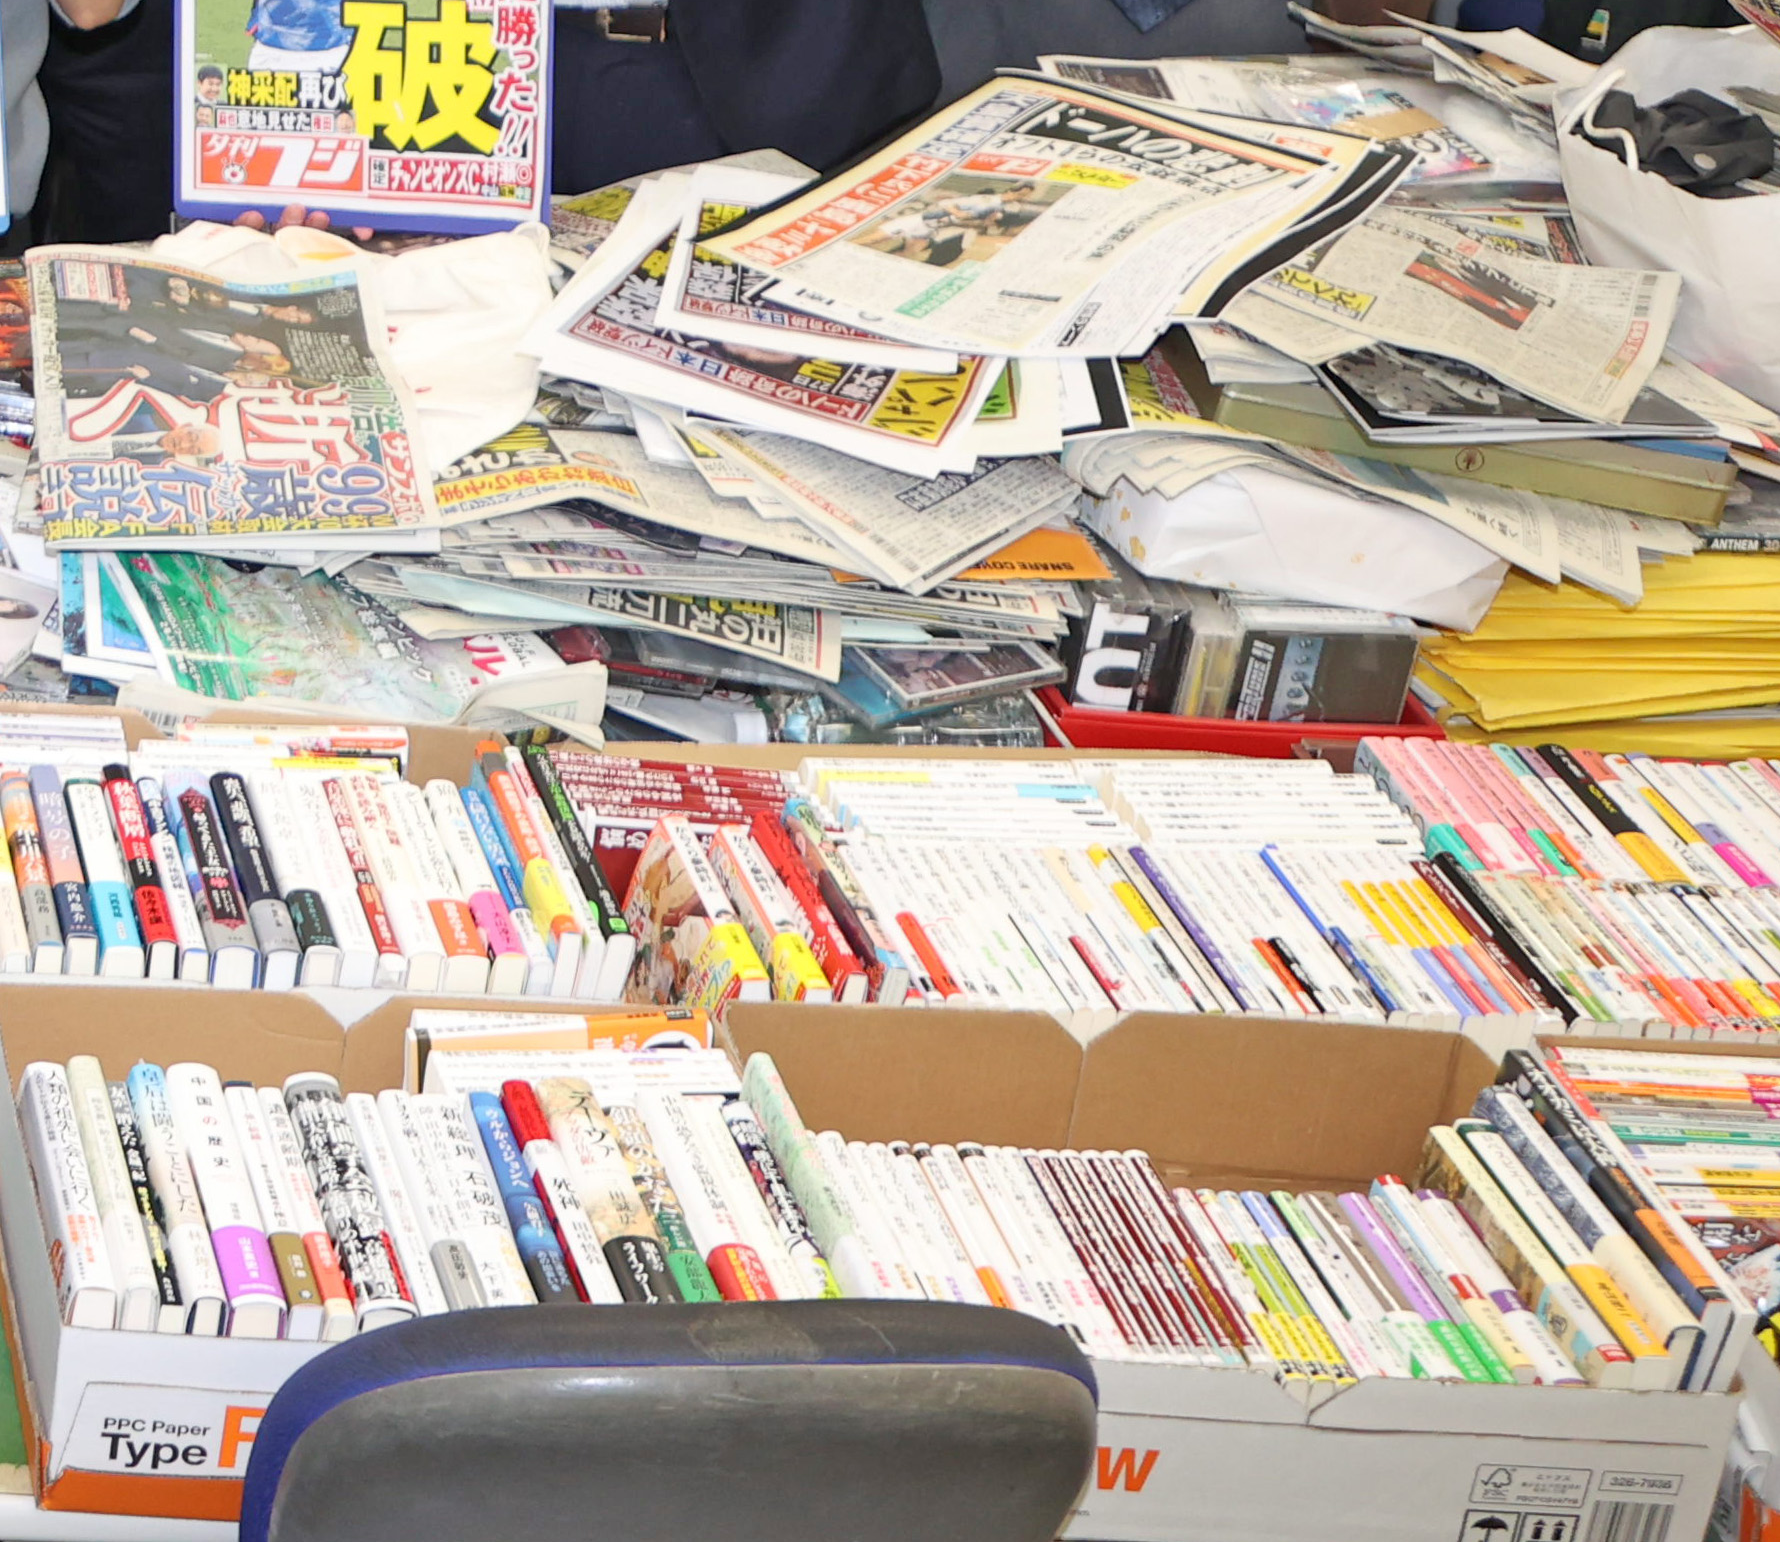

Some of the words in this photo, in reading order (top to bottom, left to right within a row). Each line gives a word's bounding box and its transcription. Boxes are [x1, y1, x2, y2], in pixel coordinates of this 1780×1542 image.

[204, 133, 362, 188] 夕刊フジ
[390, 158, 481, 193] チャンピオンズC
[727, 364, 861, 420] ドーハの奇跡
[794, 374, 829, 393] 27日
[240, 464, 392, 520] 99歳
[380, 433, 425, 516] サンスポ
[1017, 560, 1075, 572] SNARE
[1710, 538, 1760, 552] ANTHEM
[38, 789, 77, 861] 暗号の子
[142, 1067, 198, 1214] 皇后は闘うことにした
[190, 1075, 231, 1169] 中国の歴史
[441, 1106, 477, 1158] 新総理
[466, 1170, 505, 1227] 石破茂
[100, 1433, 209, 1470] Type
[102, 1417, 146, 1433] PPC
[150, 1421, 211, 1438] Paper
[1095, 1446, 1160, 1493] W
